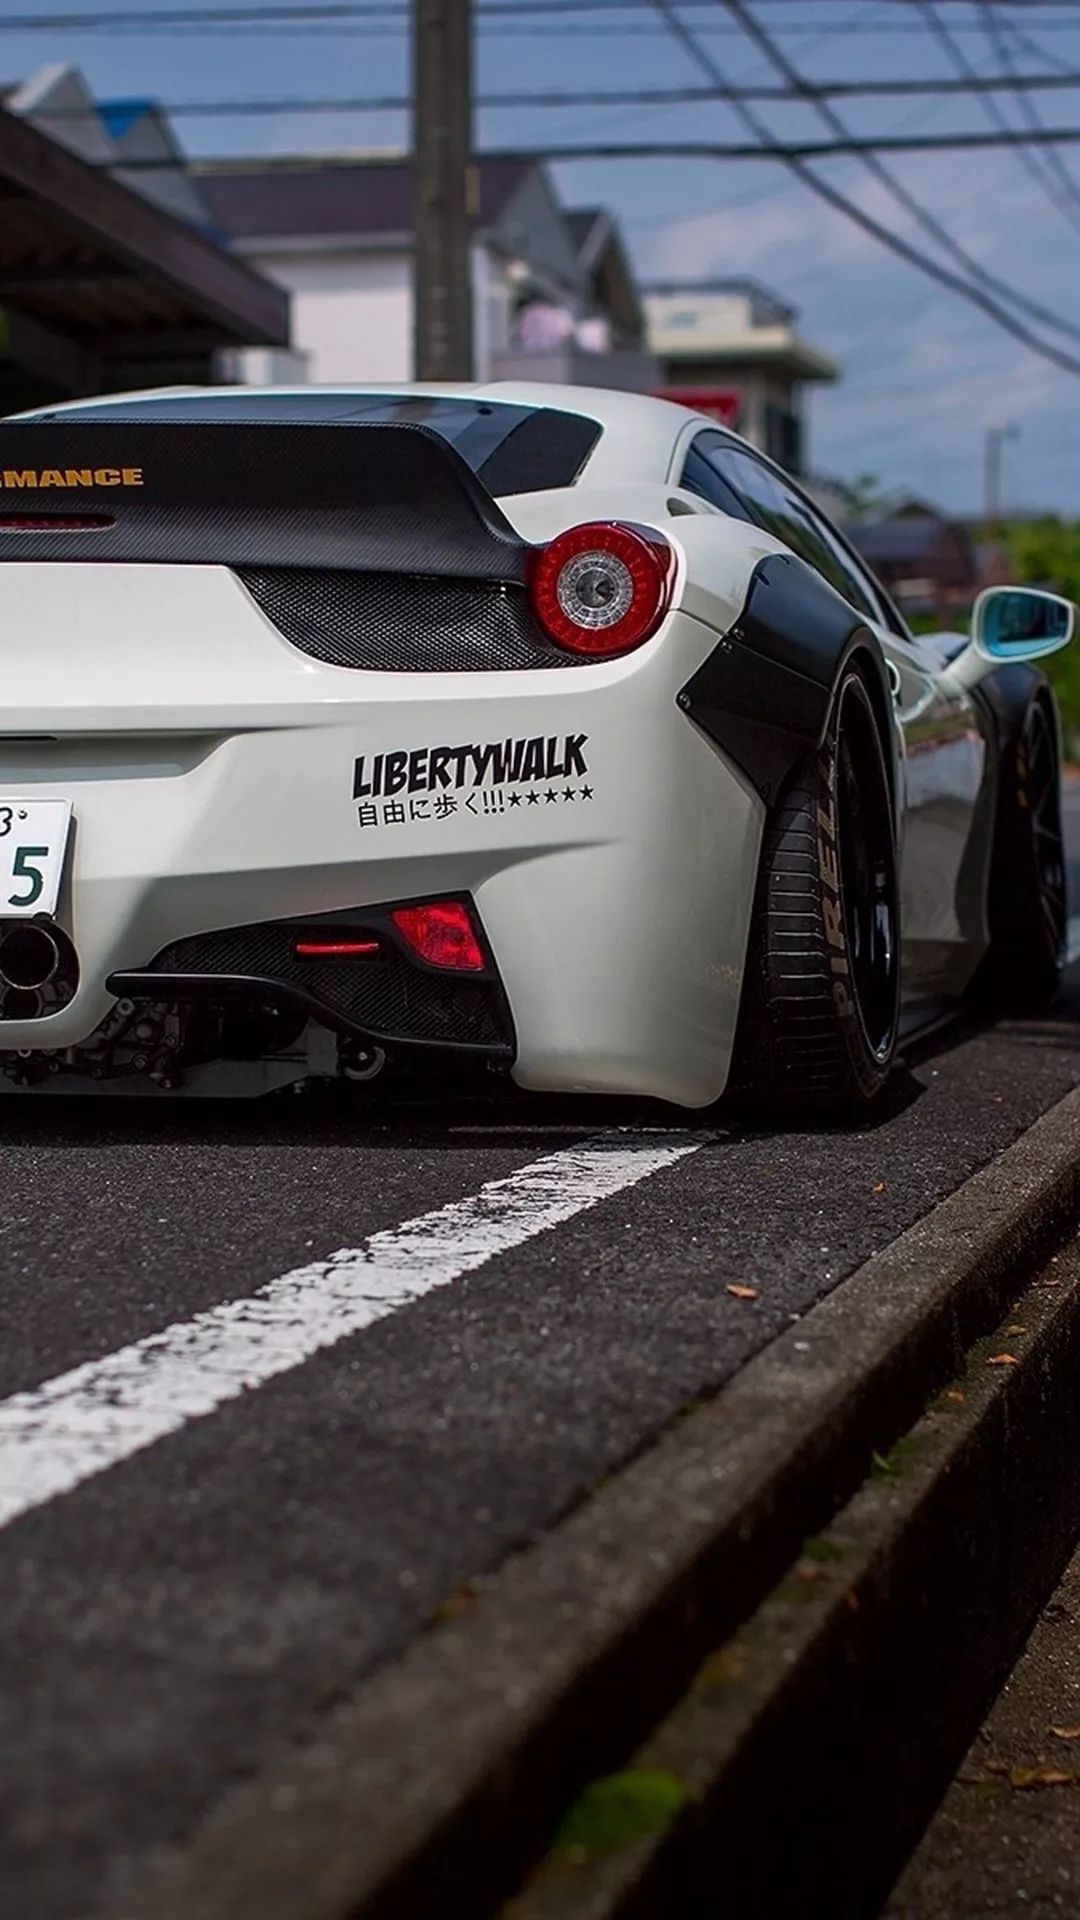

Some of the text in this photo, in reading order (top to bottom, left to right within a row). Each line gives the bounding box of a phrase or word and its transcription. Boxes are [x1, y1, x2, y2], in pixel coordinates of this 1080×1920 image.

[0, 468, 144, 488] MANCE
[353, 733, 589, 799] LIBERTYWALK
[8, 846, 49, 907] 5
